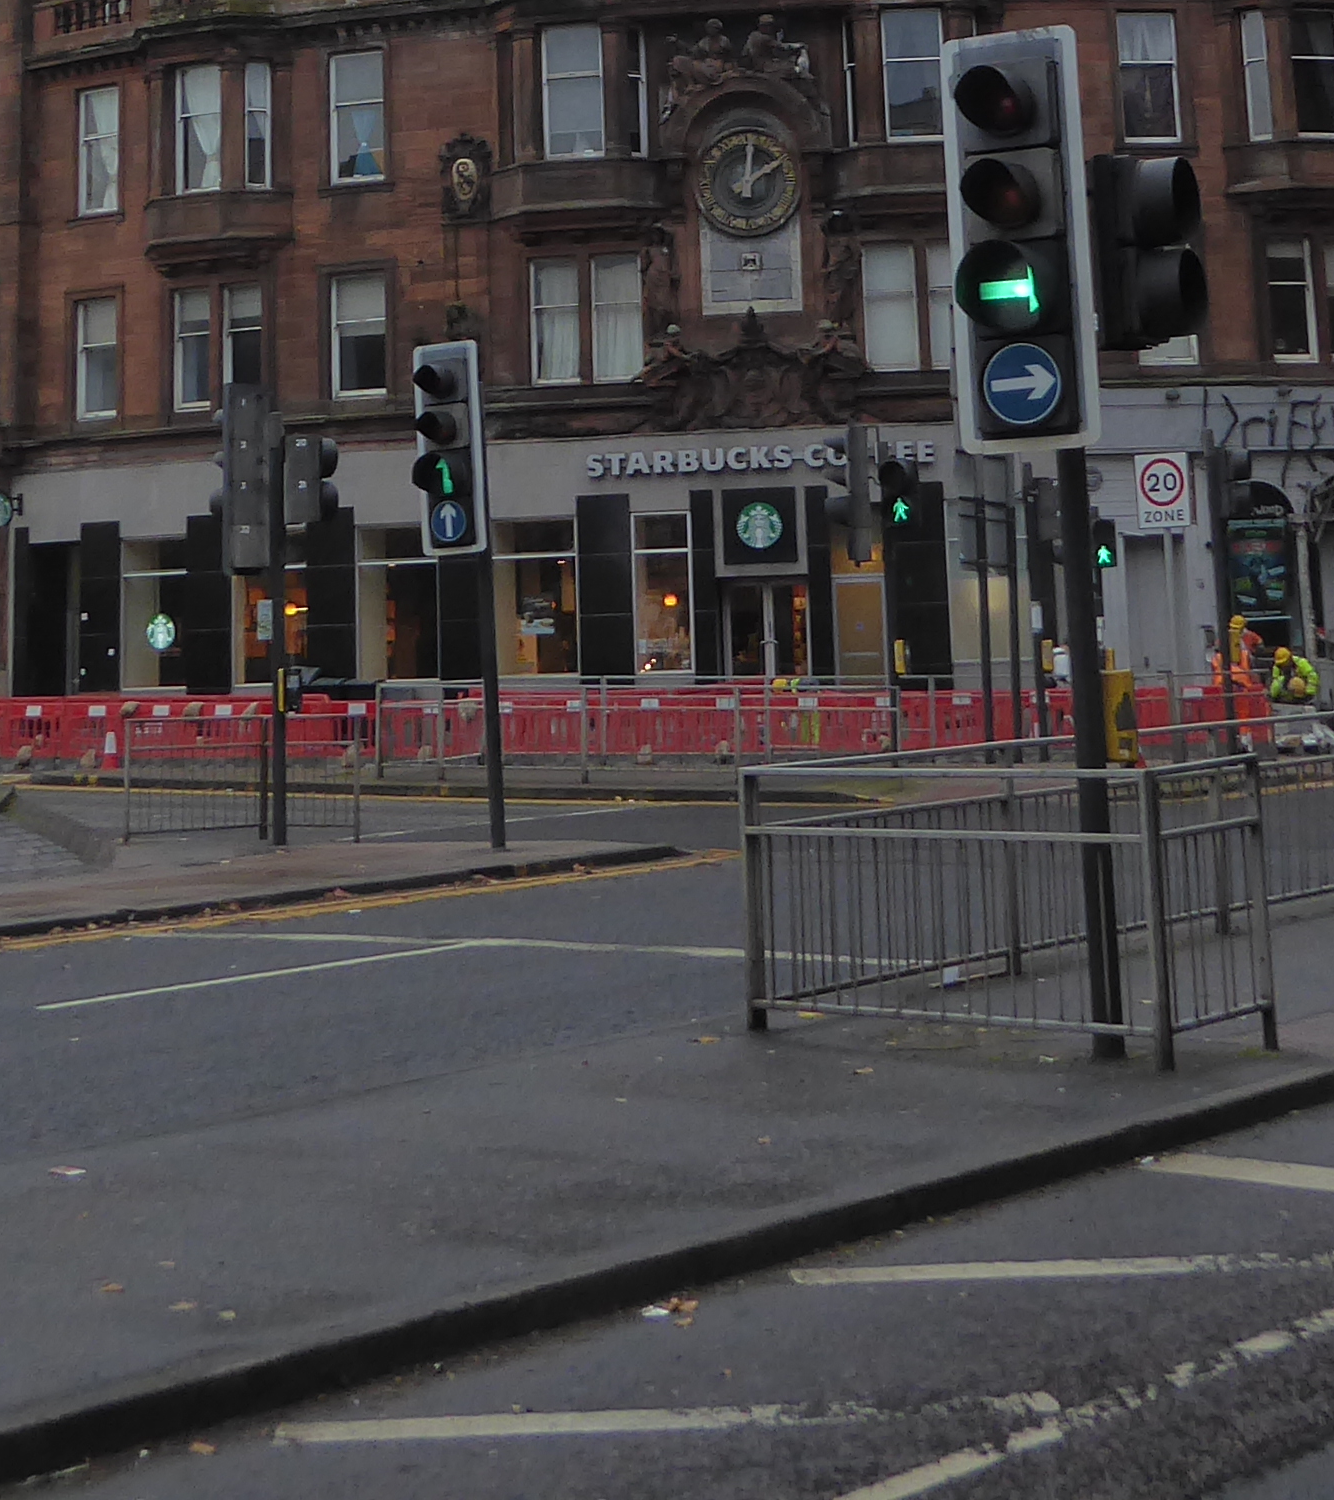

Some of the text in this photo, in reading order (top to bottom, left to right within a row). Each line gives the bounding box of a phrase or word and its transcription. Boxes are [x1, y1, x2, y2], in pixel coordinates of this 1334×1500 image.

[585, 439, 936, 479] STARBUCKS COEE
[1146, 471, 1178, 493] 20
[1143, 508, 1185, 523] ZONE
